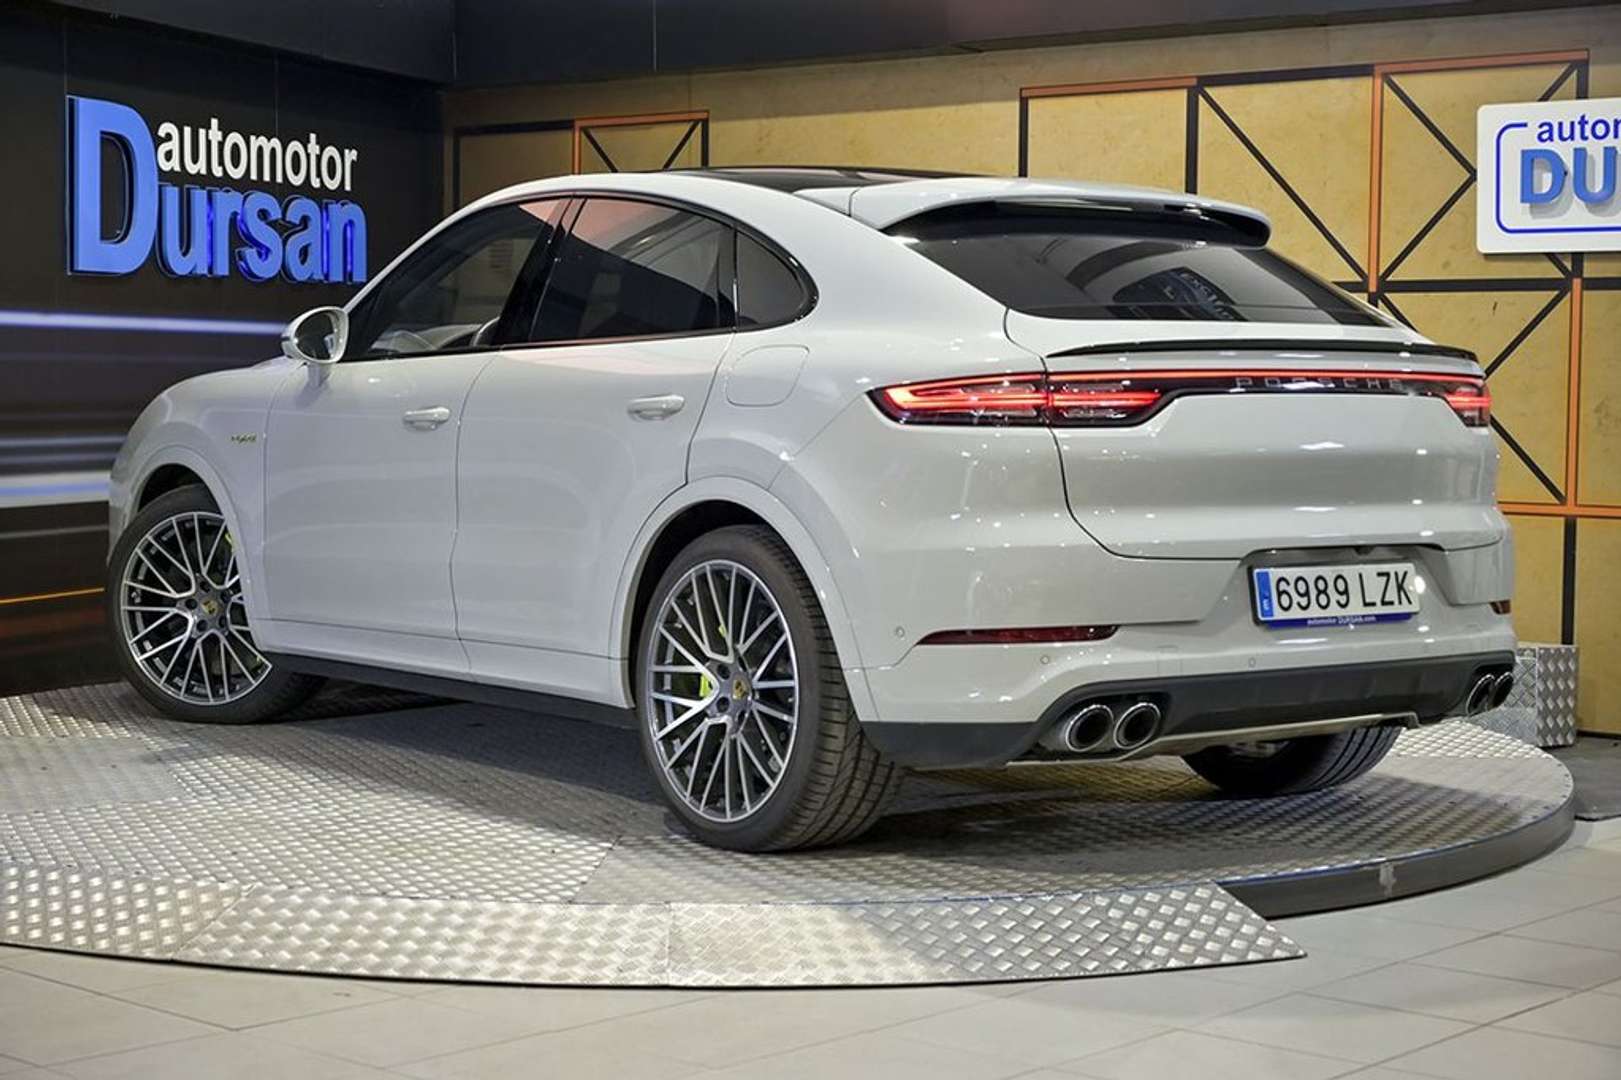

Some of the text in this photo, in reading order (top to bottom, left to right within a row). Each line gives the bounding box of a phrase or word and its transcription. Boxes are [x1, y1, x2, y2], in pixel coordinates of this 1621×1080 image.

[66, 95, 368, 284] Dursan
[156, 117, 358, 191] automotor
[1276, 571, 1413, 611] 6989 LZK
